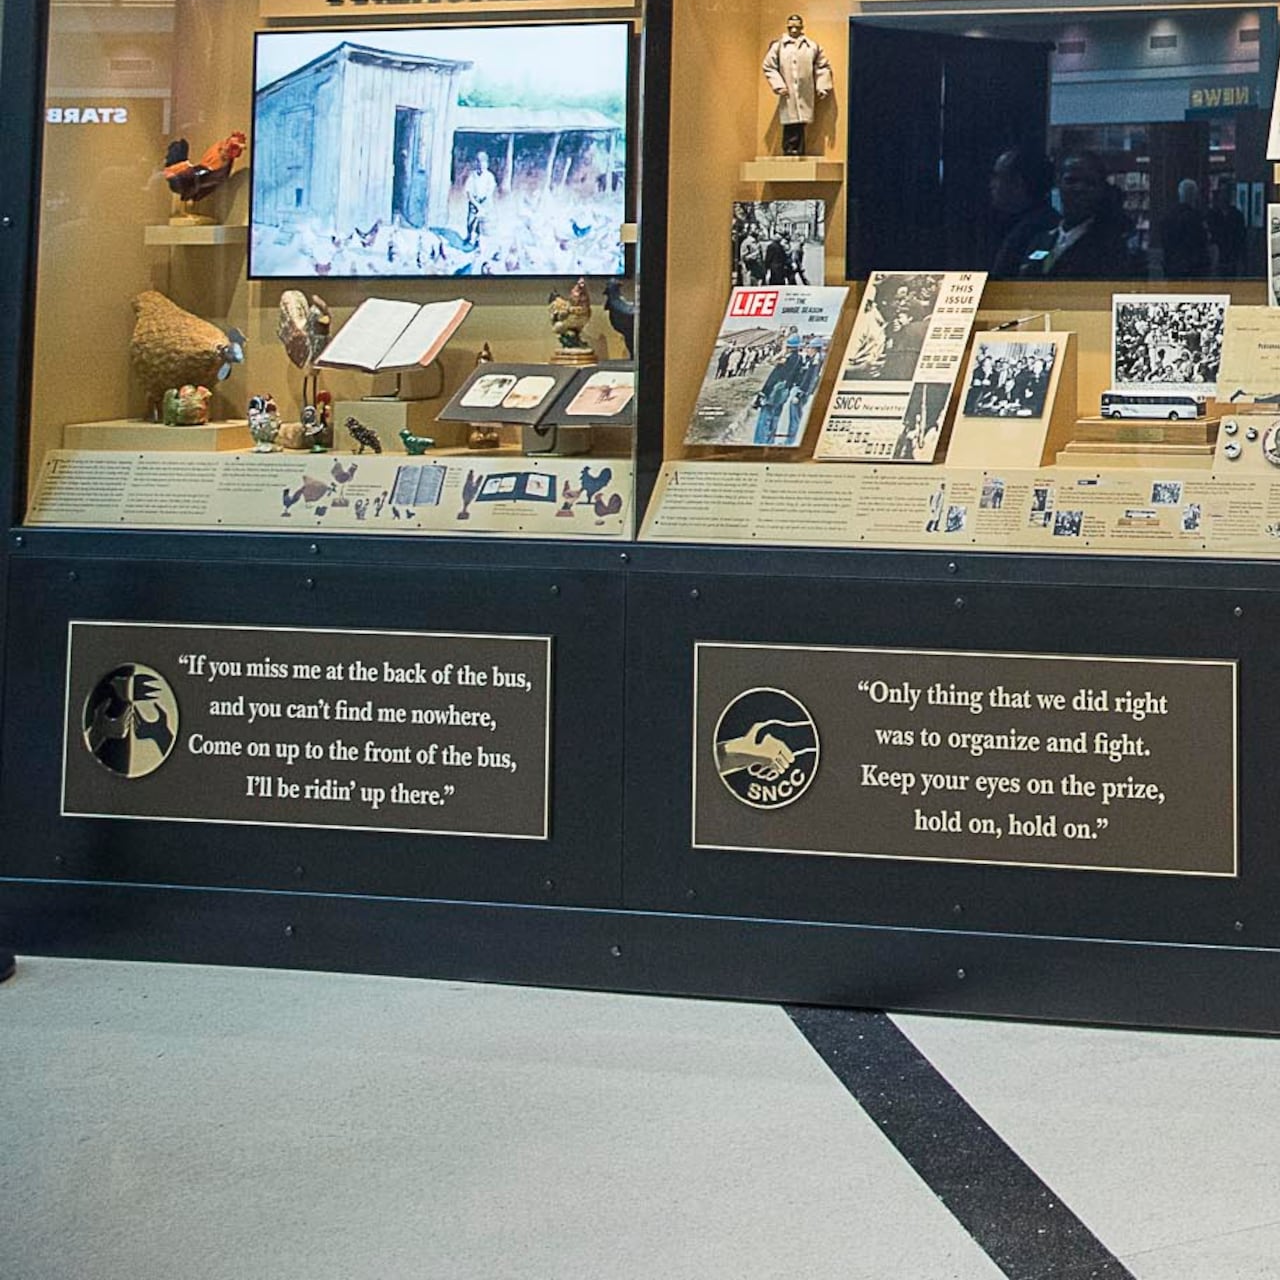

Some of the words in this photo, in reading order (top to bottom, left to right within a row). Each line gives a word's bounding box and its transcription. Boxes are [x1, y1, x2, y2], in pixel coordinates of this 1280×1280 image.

[732, 293, 777, 316] LIFE
[945, 296, 974, 304] ISSUE
[950, 285, 974, 293] THIS
[834, 397, 862, 410] SNCC
[179, 655, 206, 674] "If
[208, 662, 241, 682] you
[246, 658, 288, 678] miss
[293, 665, 321, 679] me
[326, 663, 344, 680] at
[348, 661, 378, 681] the
[383, 662, 426, 683] back
[432, 664, 454, 684] of
[457, 665, 487, 686] the
[492, 666, 531, 692] bus,
[210, 696, 244, 715] and
[248, 703, 281, 723] you
[287, 699, 330, 720] can't
[335, 700, 372, 721] find
[378, 708, 406, 722] me
[412, 704, 496, 731] nowhere,
[858, 681, 921, 711] "Only
[927, 684, 983, 714] thing
[989, 686, 1032, 708] that
[1036, 694, 1065, 710] we
[1072, 689, 1108, 711] did
[1115, 691, 1168, 721] right
[189, 734, 242, 756] Come
[247, 742, 270, 756] on
[276, 744, 299, 764] up
[305, 742, 323, 759] to
[329, 740, 358, 760] the
[364, 741, 411, 763] front
[416, 744, 438, 764] of
[442, 745, 472, 766] the
[478, 746, 516, 772] bus,
[875, 730, 914, 746] was
[920, 728, 940, 746] to
[948, 728, 1040, 756] organize
[1046, 732, 1087, 753] and
[1094, 732, 1150, 762] fight.
[246, 776, 272, 796] I'll
[278, 777, 300, 798] be
[304, 779, 355, 800] ridin'
[361, 788, 385, 809] up
[391, 783, 454, 805] there."
[747, 767, 806, 803] SNCC
[861, 764, 915, 794] Keep
[921, 774, 970, 795] your
[976, 776, 1020, 798] eyes
[1027, 779, 1054, 794] on
[1061, 774, 1095, 796] the
[1102, 776, 1164, 804] prize,
[915, 809, 962, 832] hold
[969, 818, 1002, 838] on,
[1008, 814, 1057, 837] hold
[1064, 818, 1108, 838] on."
